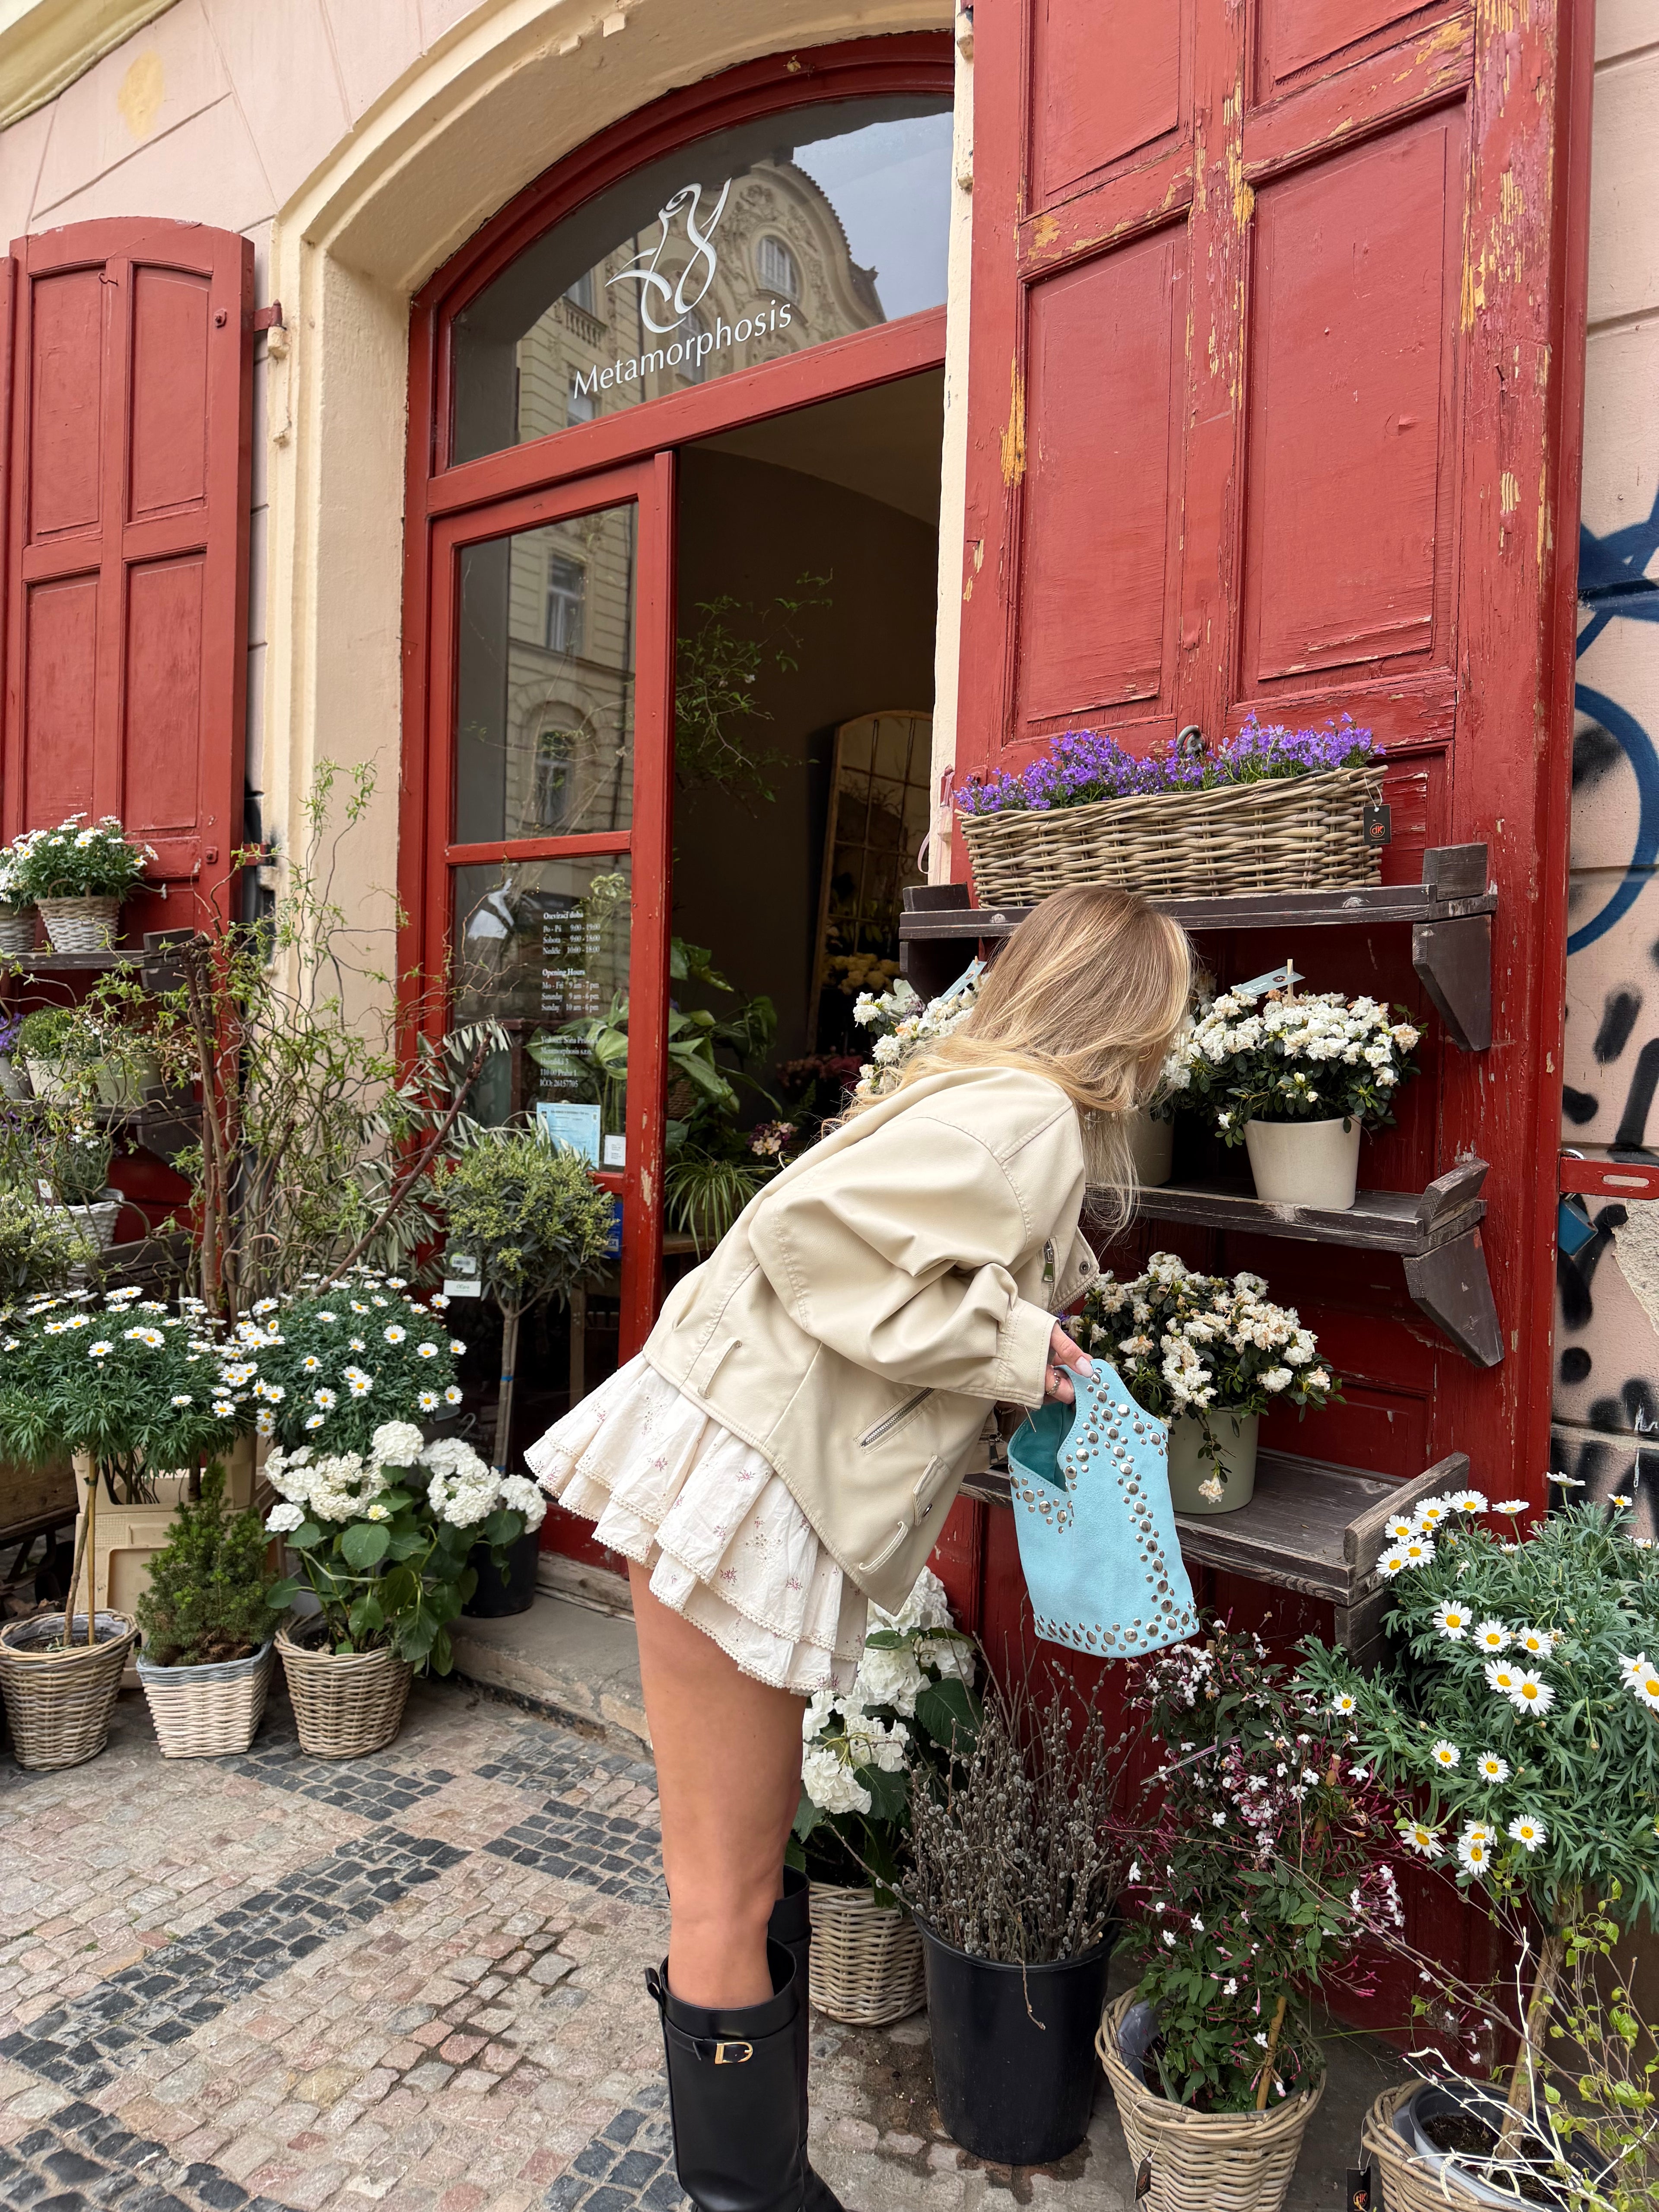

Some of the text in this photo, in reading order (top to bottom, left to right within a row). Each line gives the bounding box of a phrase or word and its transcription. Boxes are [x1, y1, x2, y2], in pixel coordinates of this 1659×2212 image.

[574, 299, 791, 399] Metamorphosis
[543, 969, 566, 979] Opening
[542, 992, 563, 1002] Saturday
[542, 1003, 560, 1013] Sunday
[541, 1047, 579, 1056] Metamorphosis
